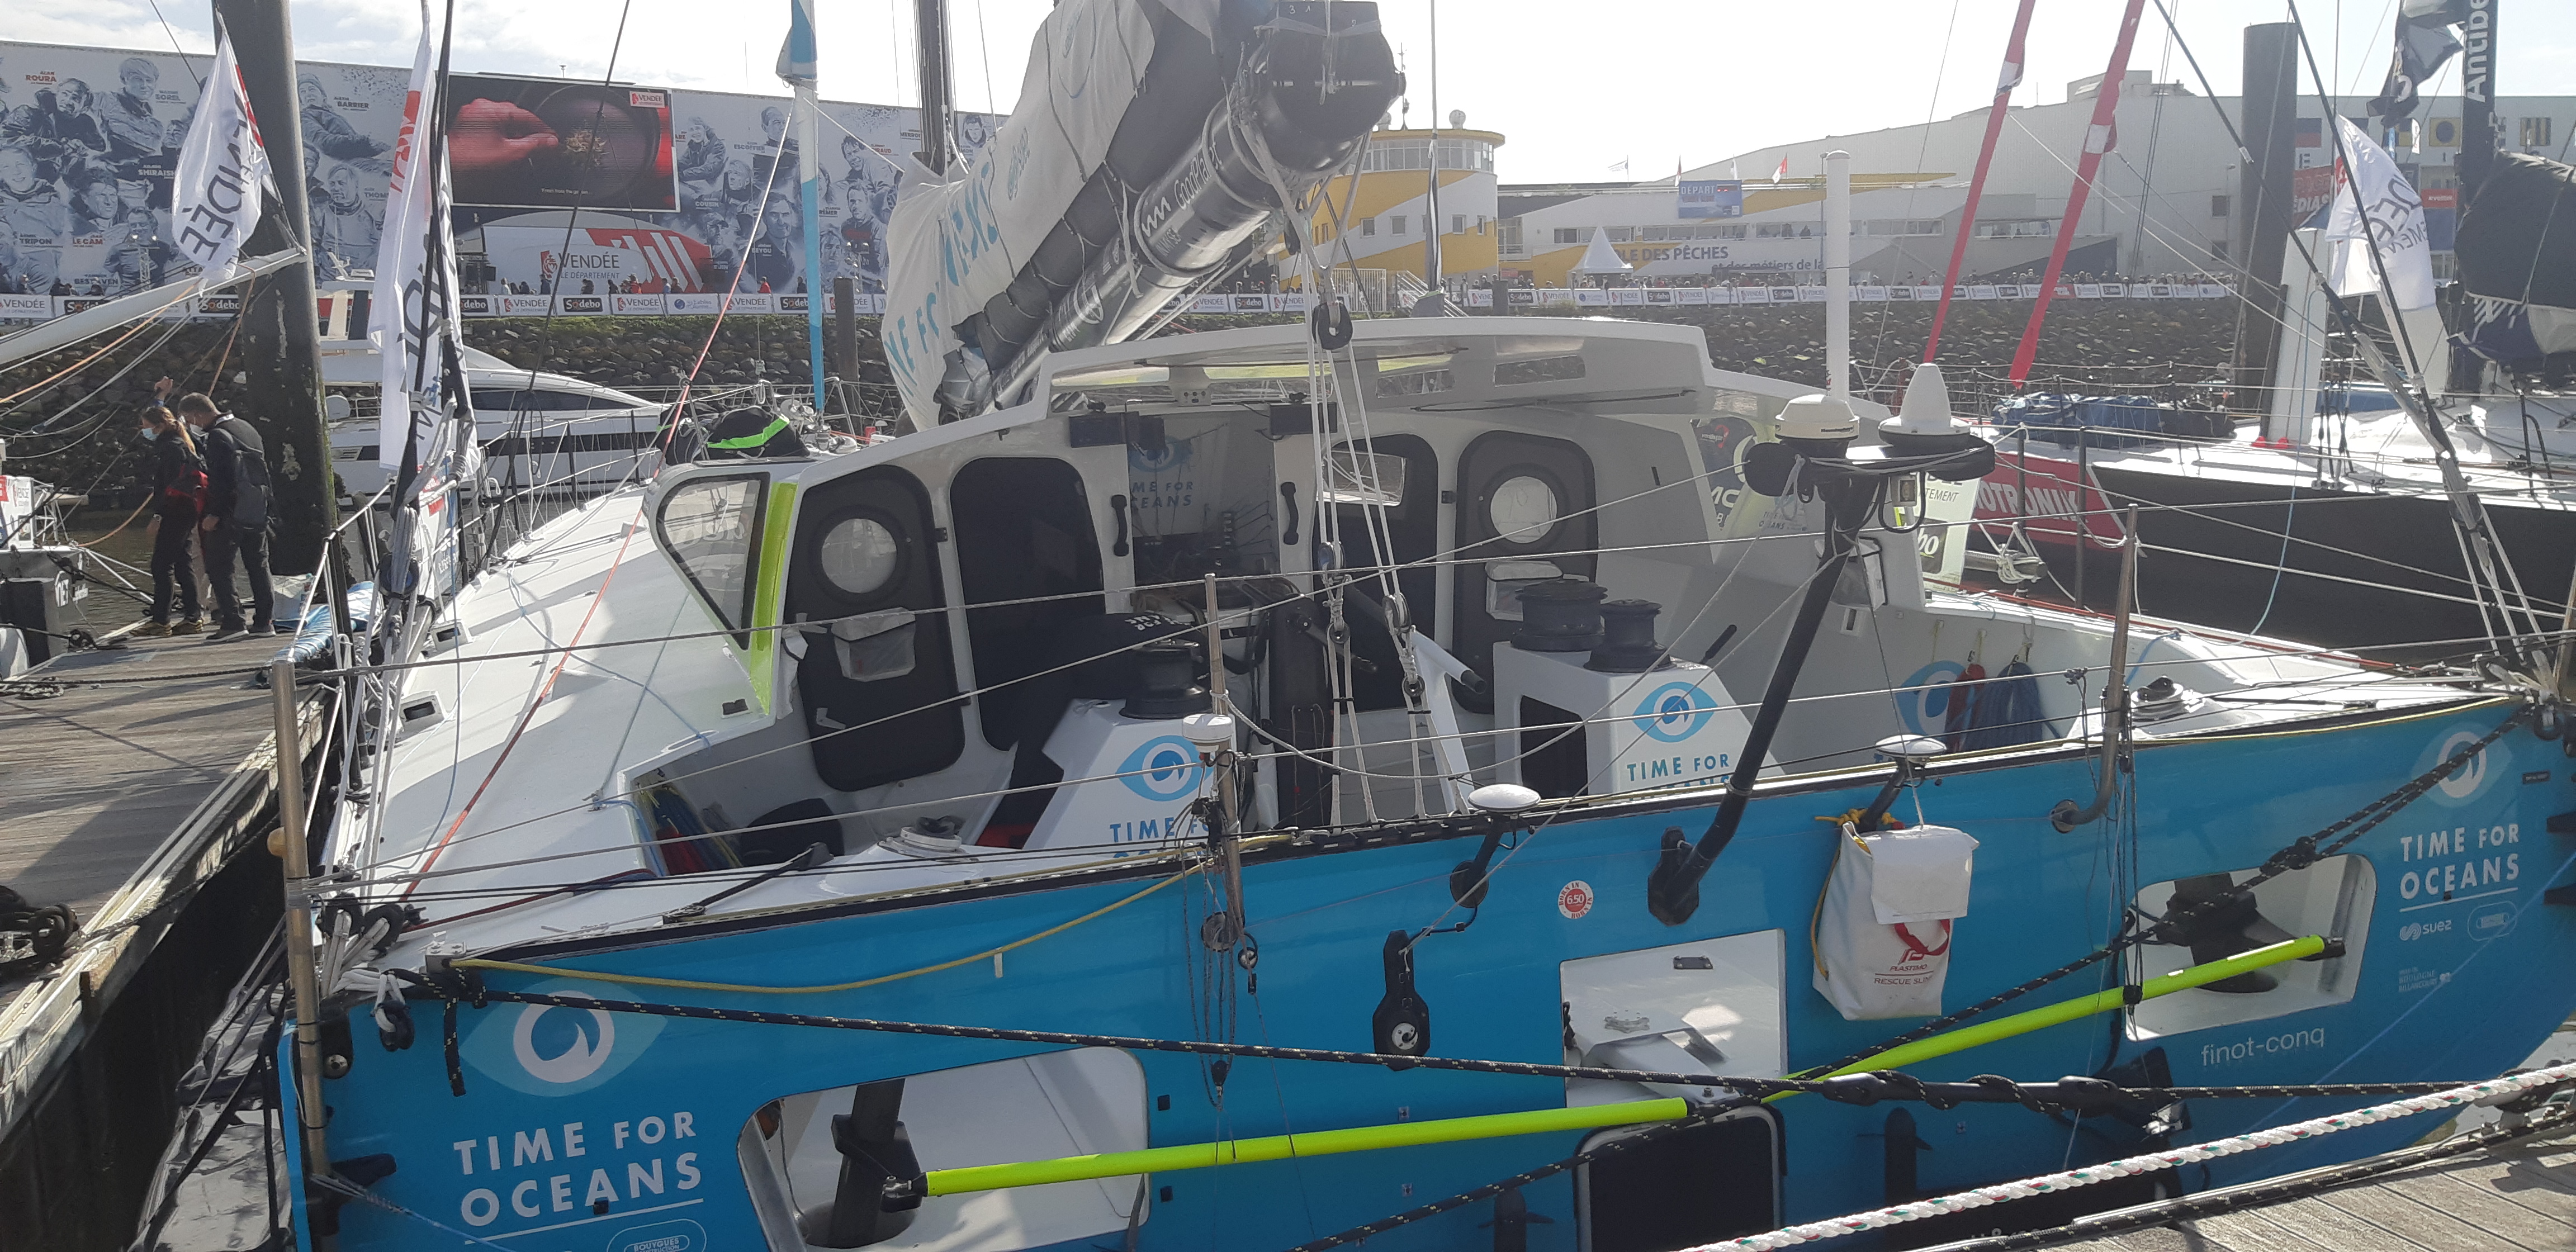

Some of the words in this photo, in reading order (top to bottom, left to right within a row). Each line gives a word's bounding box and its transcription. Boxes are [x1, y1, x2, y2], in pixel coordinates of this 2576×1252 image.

[1643, 248, 1670, 260] DES
[1673, 244, 1729, 260] PÊCHES
[558, 252, 620, 269] VENDÉE
[1796, 259, 1812, 270] de
[571, 271, 620, 279] DÉPARTEMENT
[3, 297, 45, 309] VENDÉE
[463, 297, 486, 309] debo
[513, 298, 547, 307] VENDÉE
[626, 297, 659, 306] VENDÉE
[735, 297, 766, 306] VENDÉE
[783, 298, 808, 308] Sodeb
[1166, 481, 1193, 491] FOR
[1131, 495, 1192, 509] EANS
[1976, 481, 2081, 522] OTRONIK
[1627, 756, 1682, 781] TIME
[1694, 753, 1730, 772] FOR
[1110, 817, 1175, 843] TIME
[2400, 827, 2465, 862] TIME
[2478, 823, 2519, 848] FOR
[2400, 853, 2520, 900] OCEANS
[2422, 920, 2452, 935] suez
[2201, 1027, 2325, 1066] finot-conq
[453, 1121, 586, 1175] TIME
[614, 1111, 697, 1150] FOR
[461, 1151, 702, 1227] OCEANS
[633, 1237, 680, 1252] BOUYGUES
